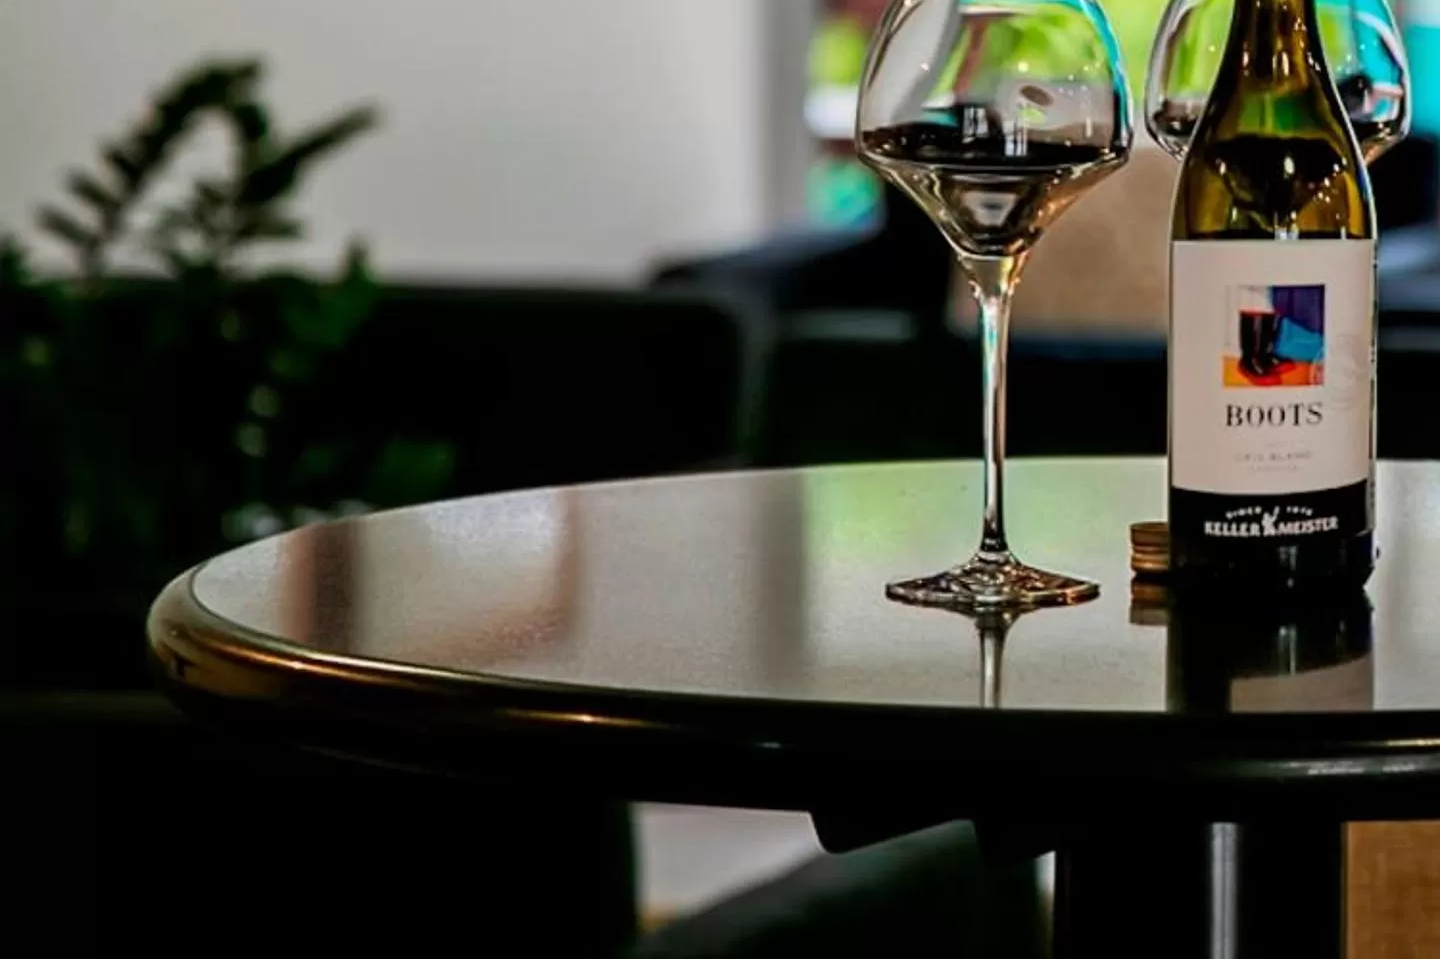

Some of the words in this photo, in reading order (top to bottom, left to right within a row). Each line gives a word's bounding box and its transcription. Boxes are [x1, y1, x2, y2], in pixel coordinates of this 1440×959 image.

[1225, 402, 1324, 427] BOOTS
[1203, 521, 1260, 537] KELLER
[1278, 515, 1338, 535] MEISTER
